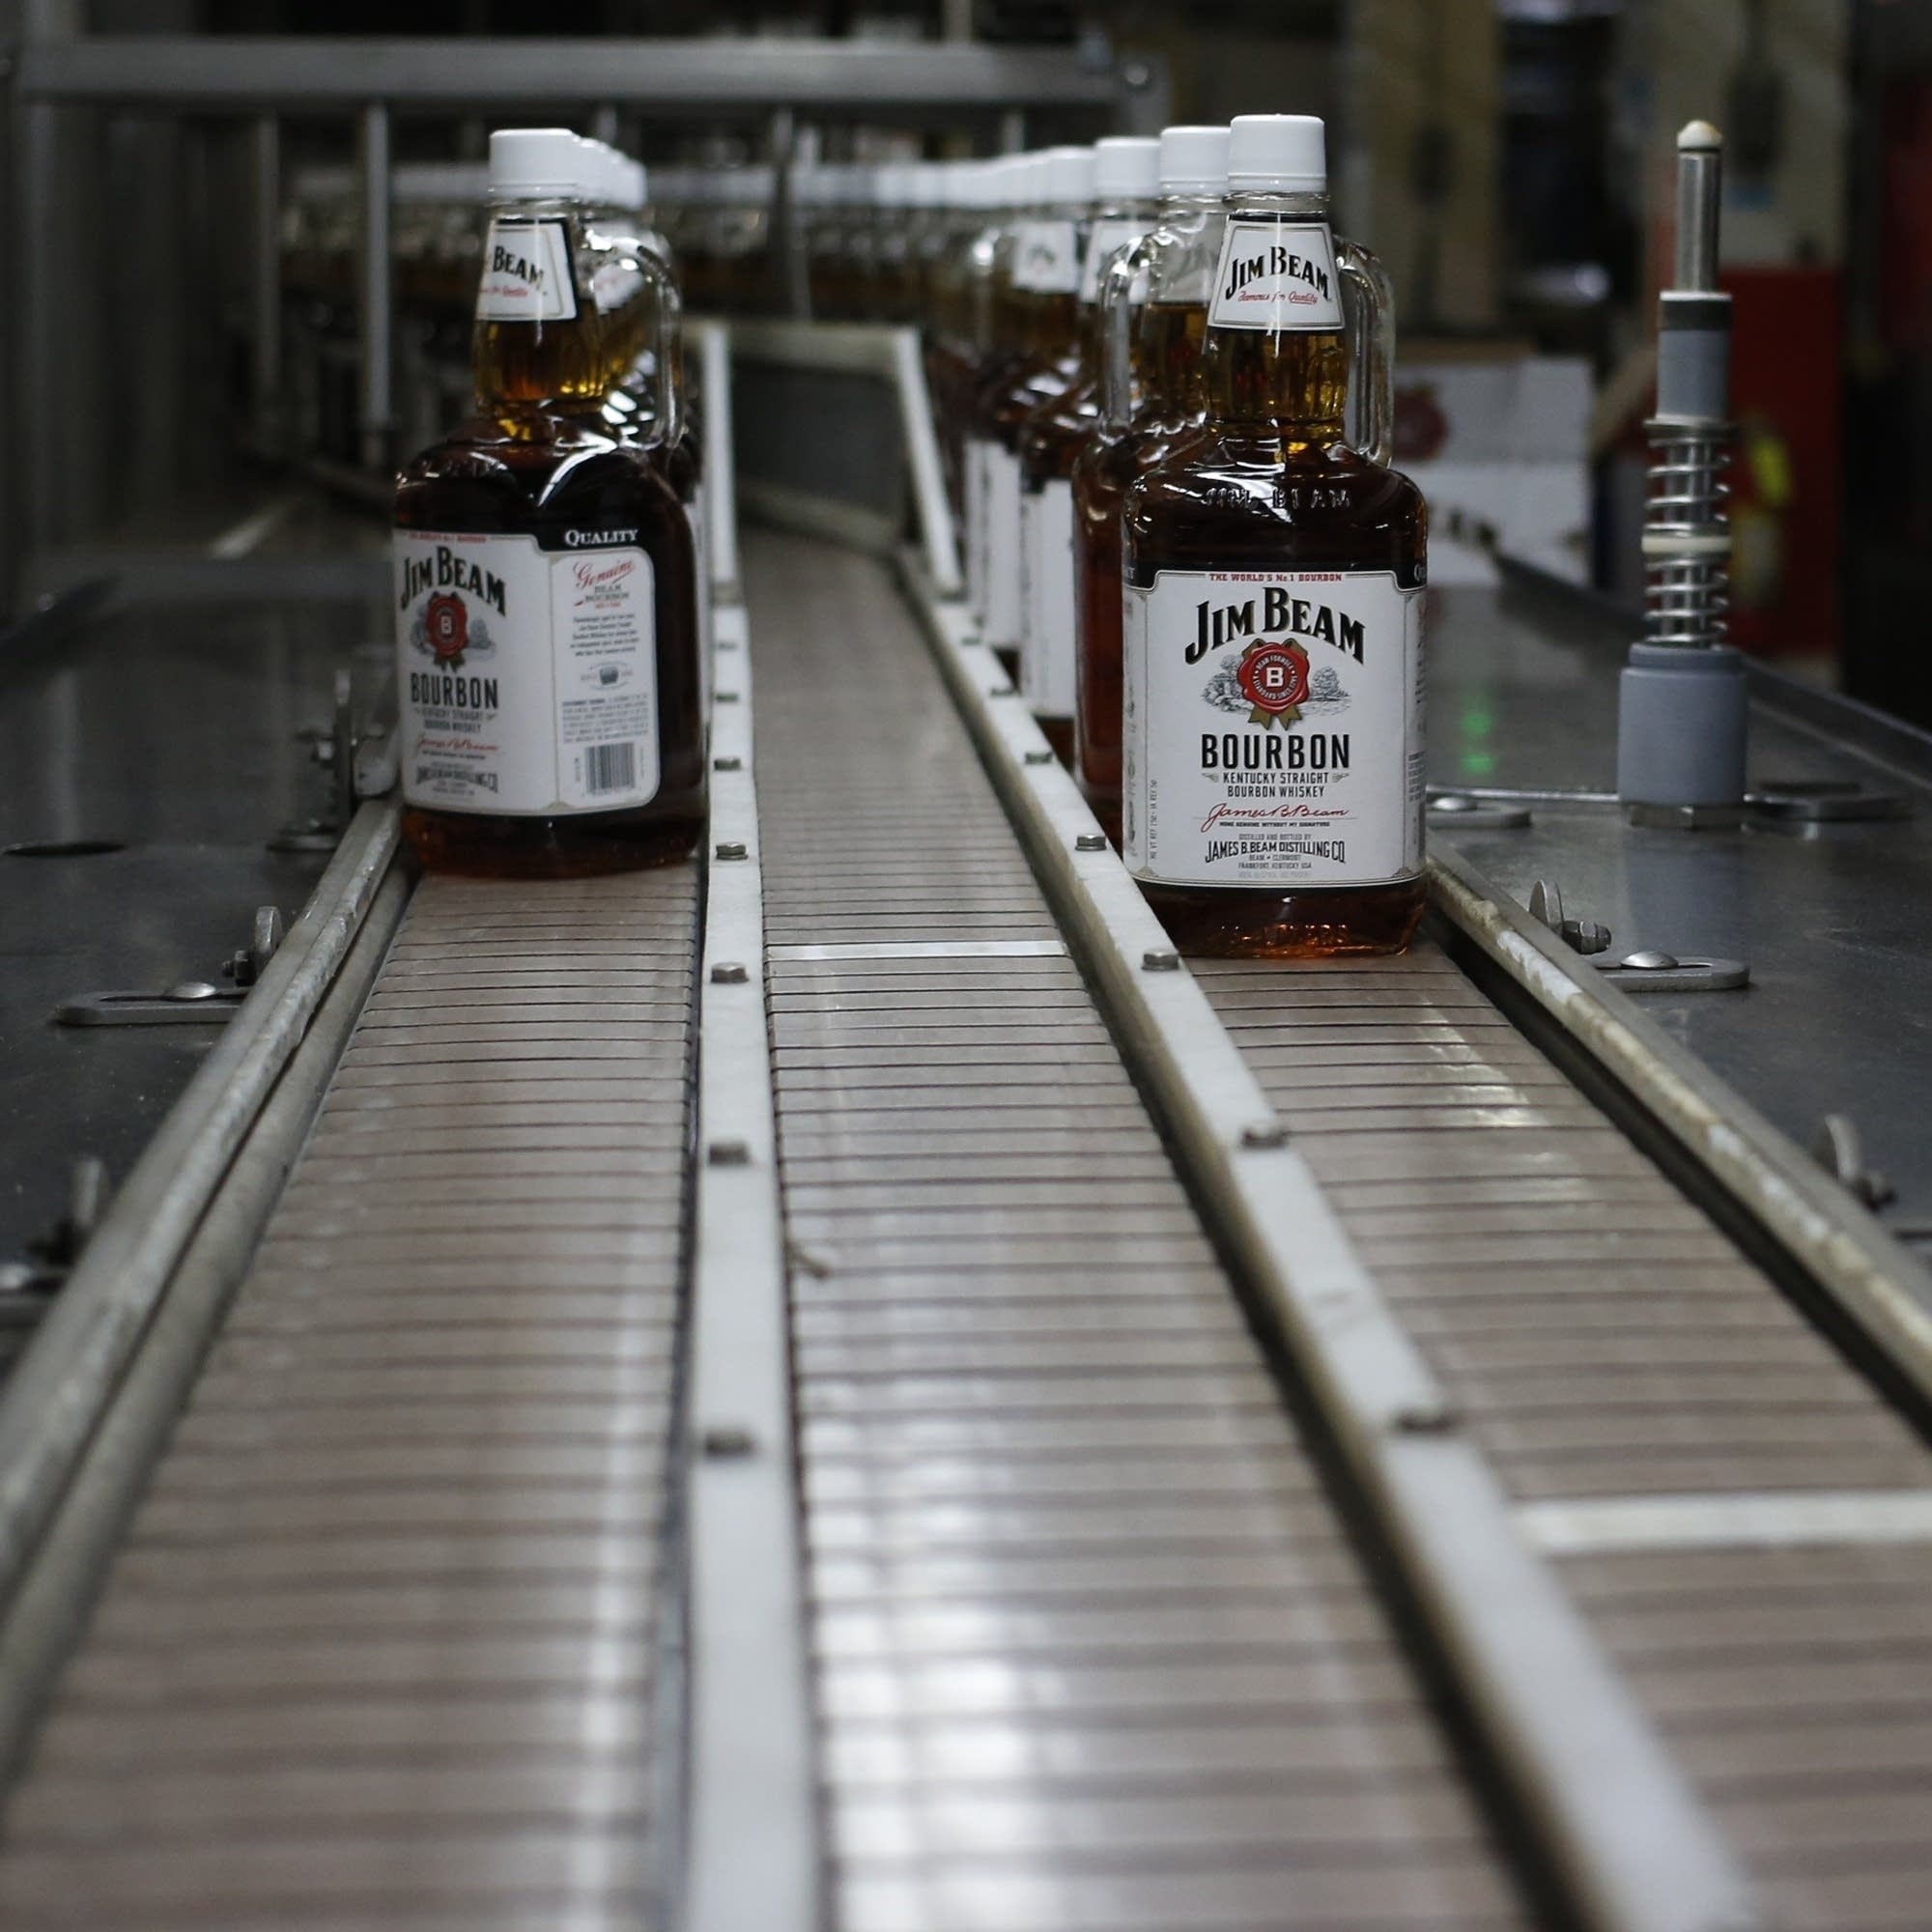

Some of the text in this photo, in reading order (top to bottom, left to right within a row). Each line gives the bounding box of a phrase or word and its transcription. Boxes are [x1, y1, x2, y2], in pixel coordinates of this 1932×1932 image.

[1225, 245, 1329, 302] JIM BEAM
[1289, 291, 1319, 305] Quality
[564, 529, 639, 548] QUALITY
[400, 545, 506, 616] JIM BEAM
[1209, 573, 1228, 582] THE
[1298, 573, 1342, 582] BOURBON
[440, 615, 452, 635] B
[1184, 586, 1366, 666] JIM BEAM
[1270, 654, 1294, 670] FORMULA
[1265, 667, 1284, 688] B
[411, 672, 498, 710] BOURBON
[1202, 733, 1350, 770] BOURBON
[1223, 772, 1329, 784] KENTUCKY STRAIGHT
[1228, 785, 1324, 798] BOURBON WHISKEY
[1201, 803, 1269, 832] James
[1292, 804, 1350, 818] Beam
[1206, 840, 1238, 863] JAMES
[1250, 841, 1277, 853] BEAM
[1279, 841, 1330, 858] DISTILLING
